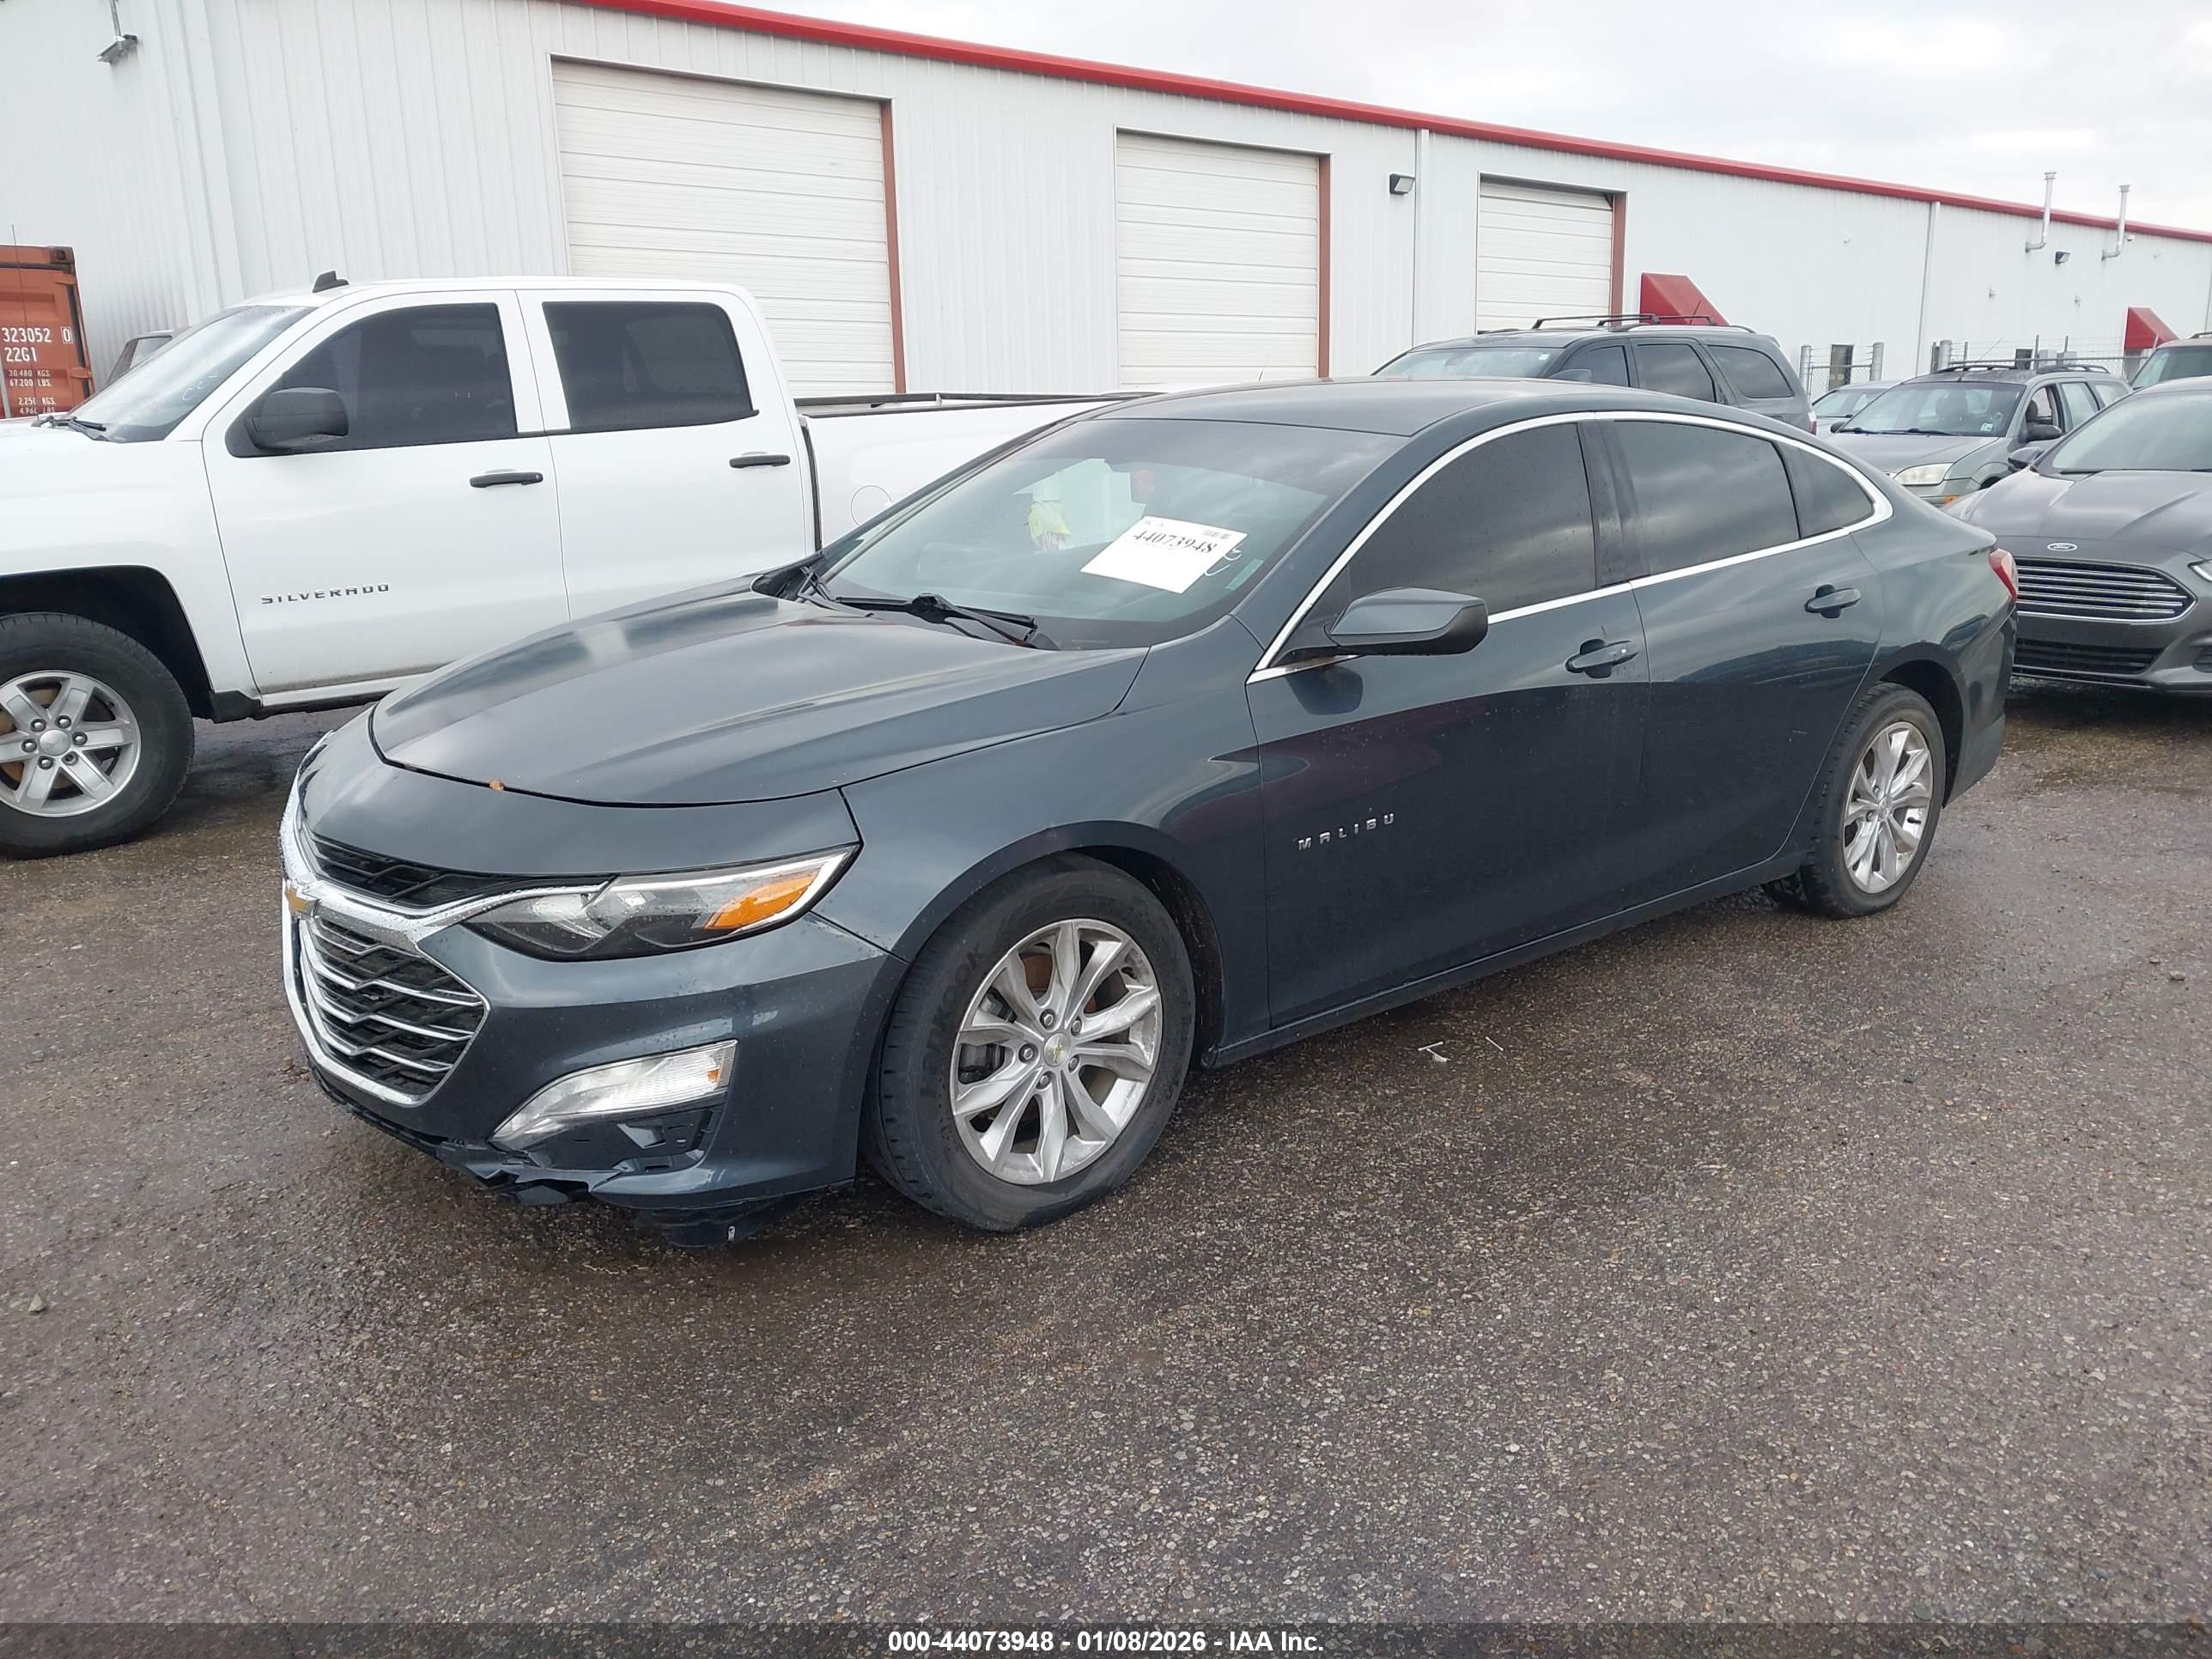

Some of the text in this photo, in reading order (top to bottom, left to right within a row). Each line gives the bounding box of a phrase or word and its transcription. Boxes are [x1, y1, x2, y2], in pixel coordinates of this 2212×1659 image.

[1, 327, 71, 343] 323052 0
[4, 346, 37, 362] 22G1
[1133, 529, 1218, 554] 44073948
[261, 583, 389, 605] SILVERADO
[1297, 813, 1395, 850] MALIBU
